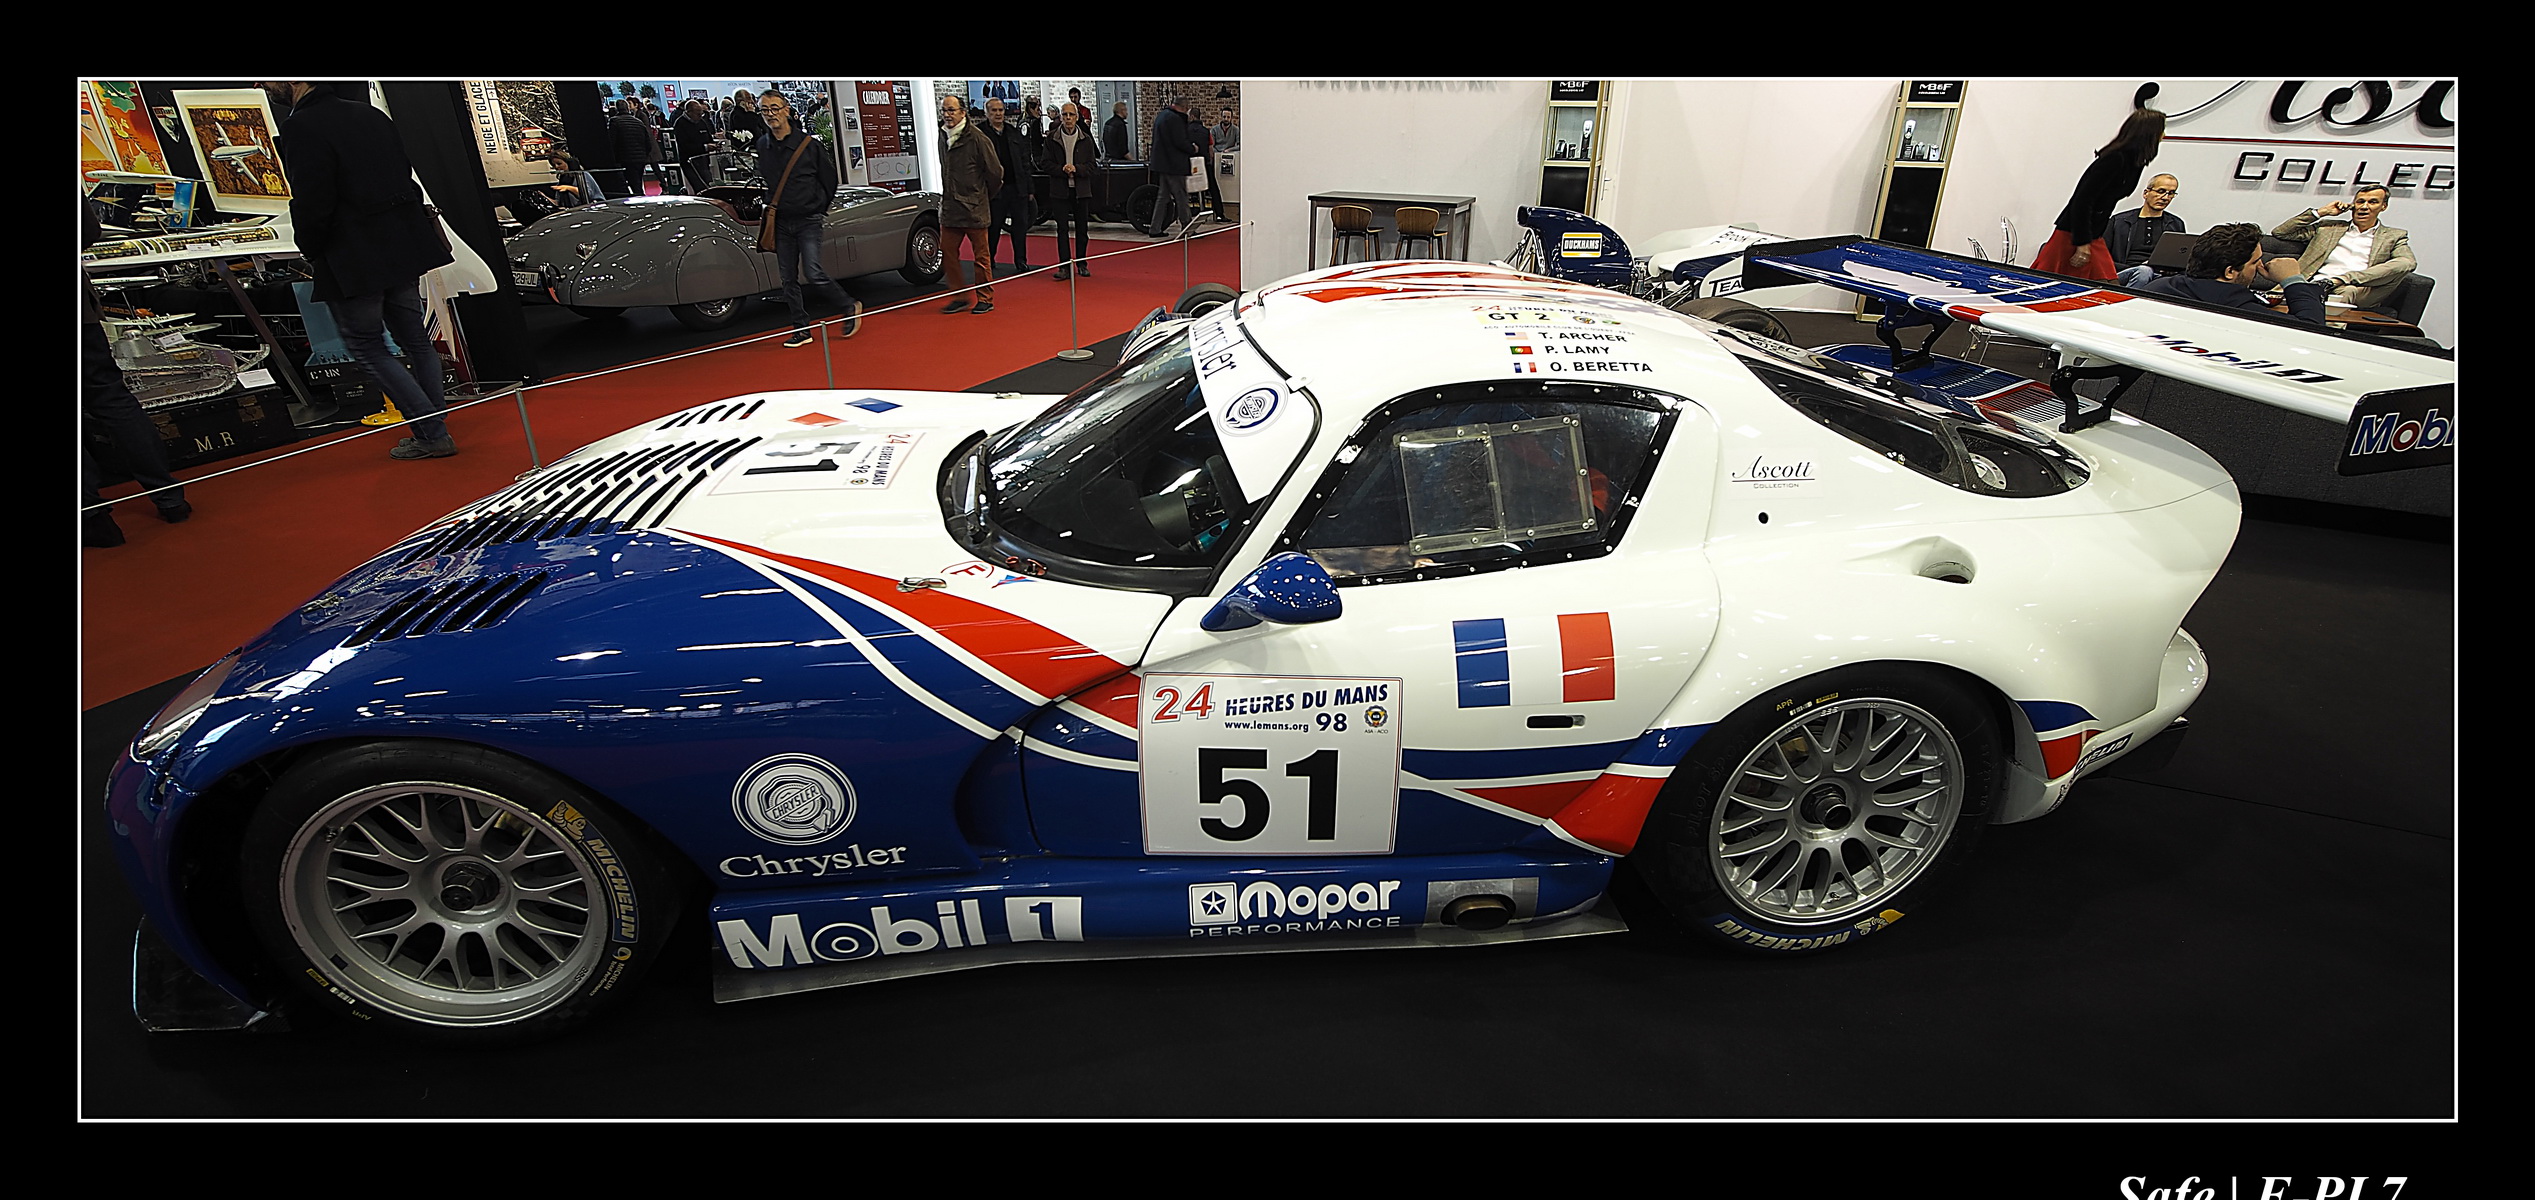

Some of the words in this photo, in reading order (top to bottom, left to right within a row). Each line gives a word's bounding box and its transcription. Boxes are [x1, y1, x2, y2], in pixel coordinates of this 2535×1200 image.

[470, 80, 488, 111] GLACE
[477, 113, 491, 126] ET
[480, 127, 498, 154] NEIGE
[1564, 239, 1600, 250] DUCKHAMS
[1708, 275, 1743, 297] TEA
[1488, 312, 1520, 321] GT
[1534, 313, 1551, 321] 2
[1537, 331, 1553, 340] T.
[1559, 332, 1628, 343] ARCHER
[1544, 345, 1559, 354] P.
[1563, 345, 1610, 355] LAMY
[2143, 334, 2284, 370] Mobil
[1549, 361, 1568, 372] O.
[1573, 361, 1653, 373] BERETTA
[1731, 455, 1814, 479] Ascott
[1151, 682, 1216, 724] 24
[1225, 693, 1295, 717] HEURES
[1301, 690, 1328, 710] DU
[1333, 684, 1388, 706] MANS
[1224, 720, 1309, 733] www.lemans.org
[1315, 712, 1348, 733] 98
[772, 784, 819, 820] CHRYSLER
[1198, 748, 1339, 841] 51
[719, 844, 907, 878] Chrysler
[587, 837, 635, 939] MICHELIN
[717, 899, 987, 969] Mobil
[1190, 916, 1401, 938] PERFORMANCE
[1714, 919, 1851, 950] MICHELIN
[604, 963, 626, 991] MICHELIN
